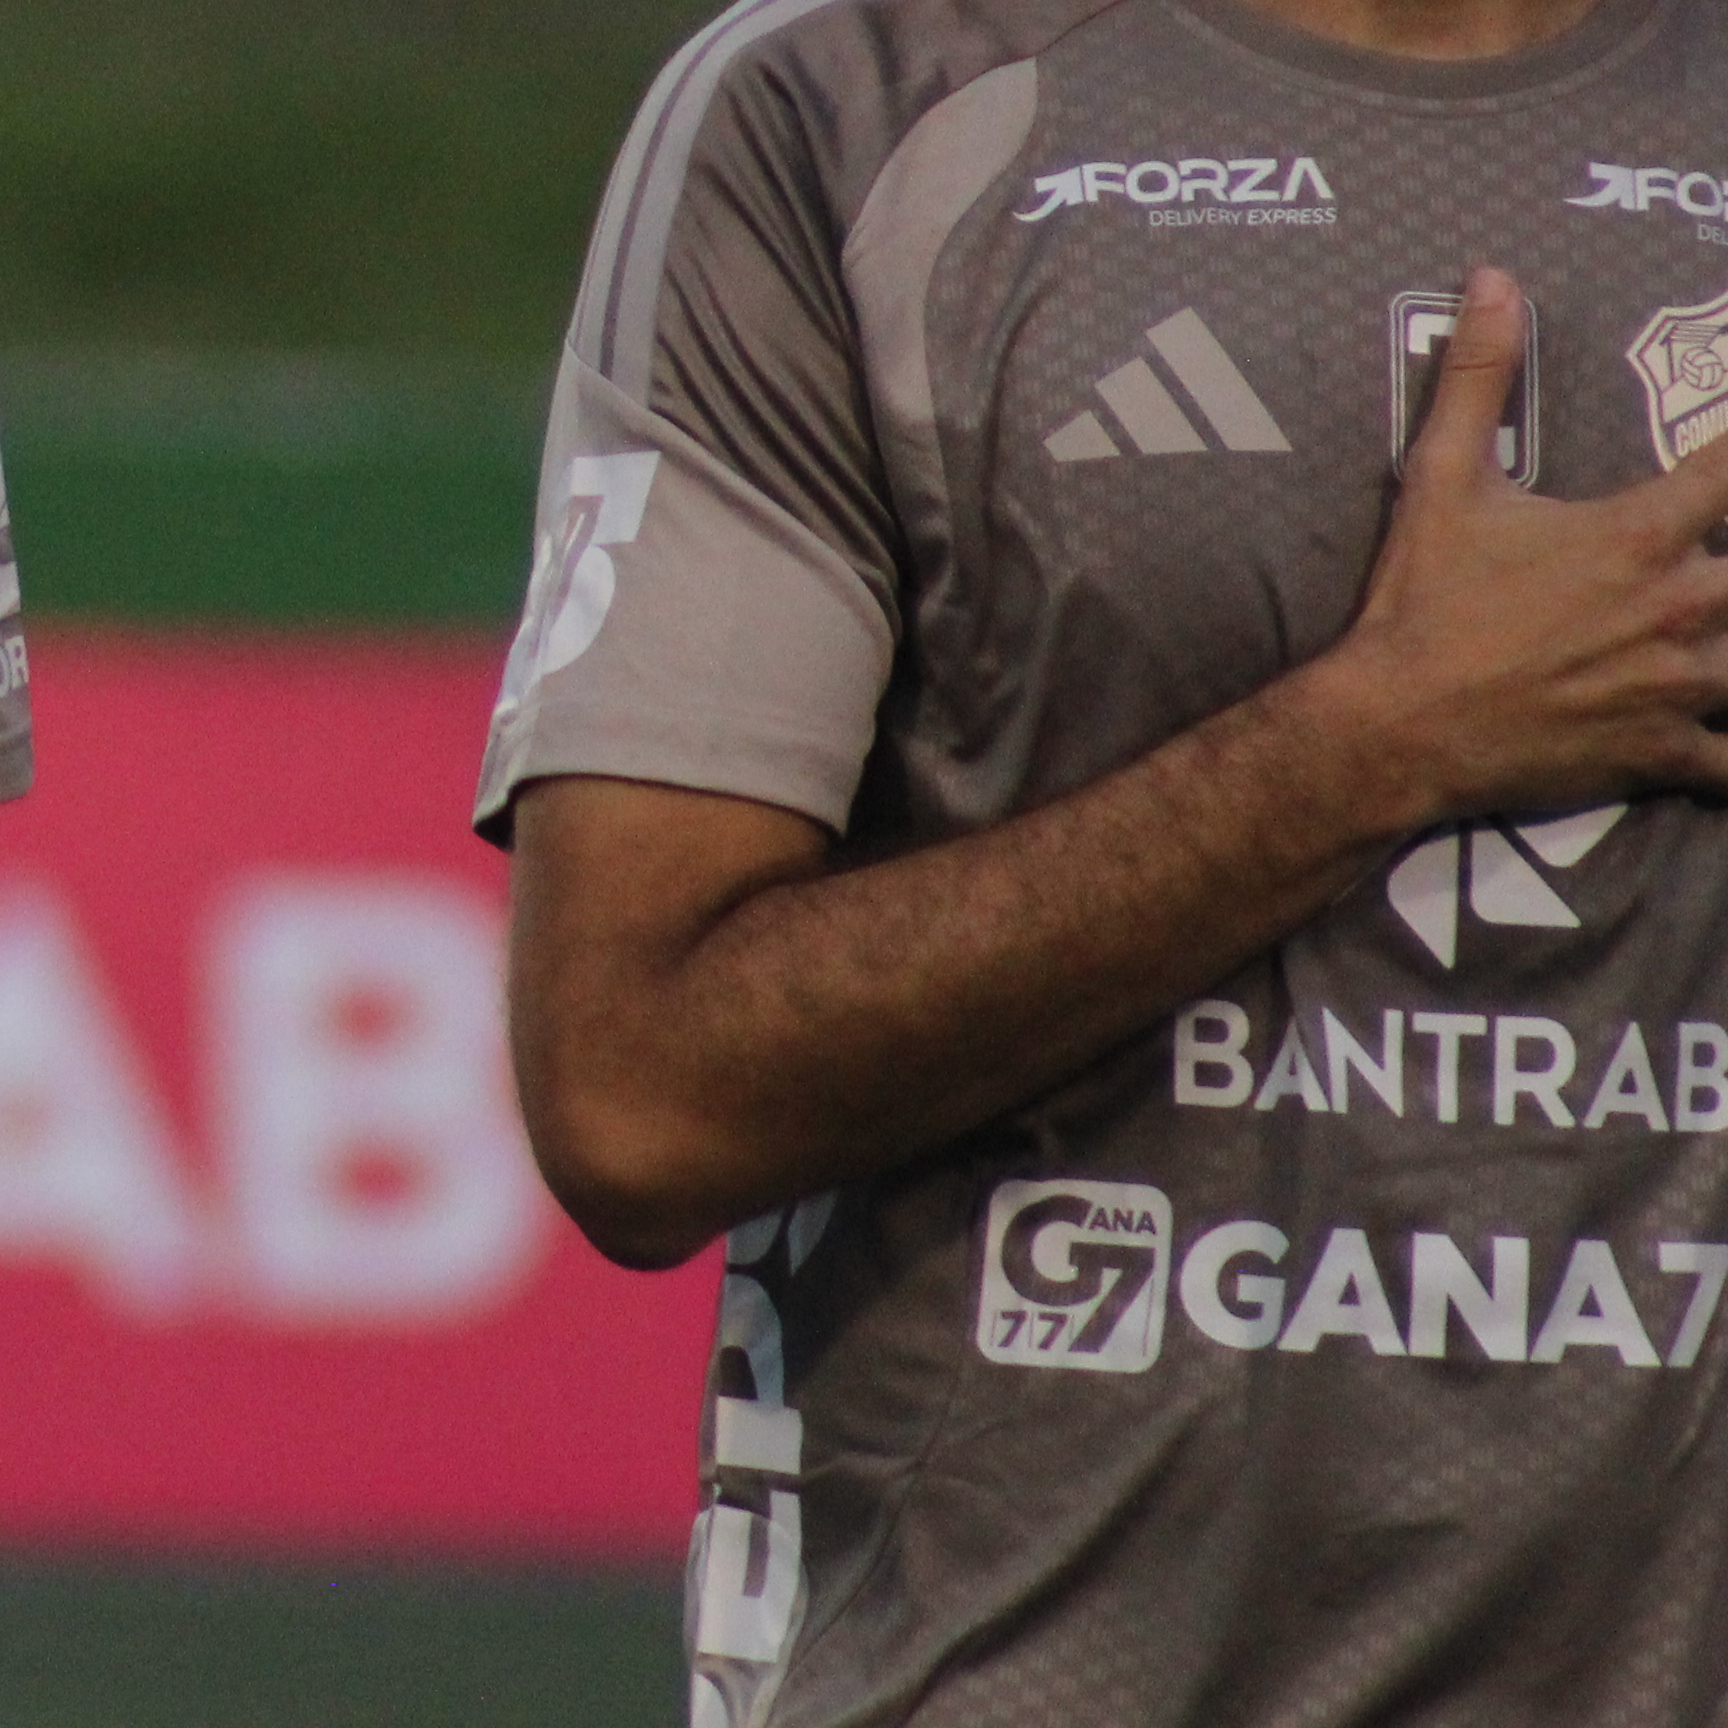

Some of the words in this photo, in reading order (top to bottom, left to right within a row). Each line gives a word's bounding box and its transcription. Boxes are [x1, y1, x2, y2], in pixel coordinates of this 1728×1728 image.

[1081, 156, 1335, 203] FORZA
[1149, 206, 1243, 227] DELIVERY
[1247, 206, 1339, 225] EXPRESS
[1173, 999, 1728, 1132] BANTRAB
